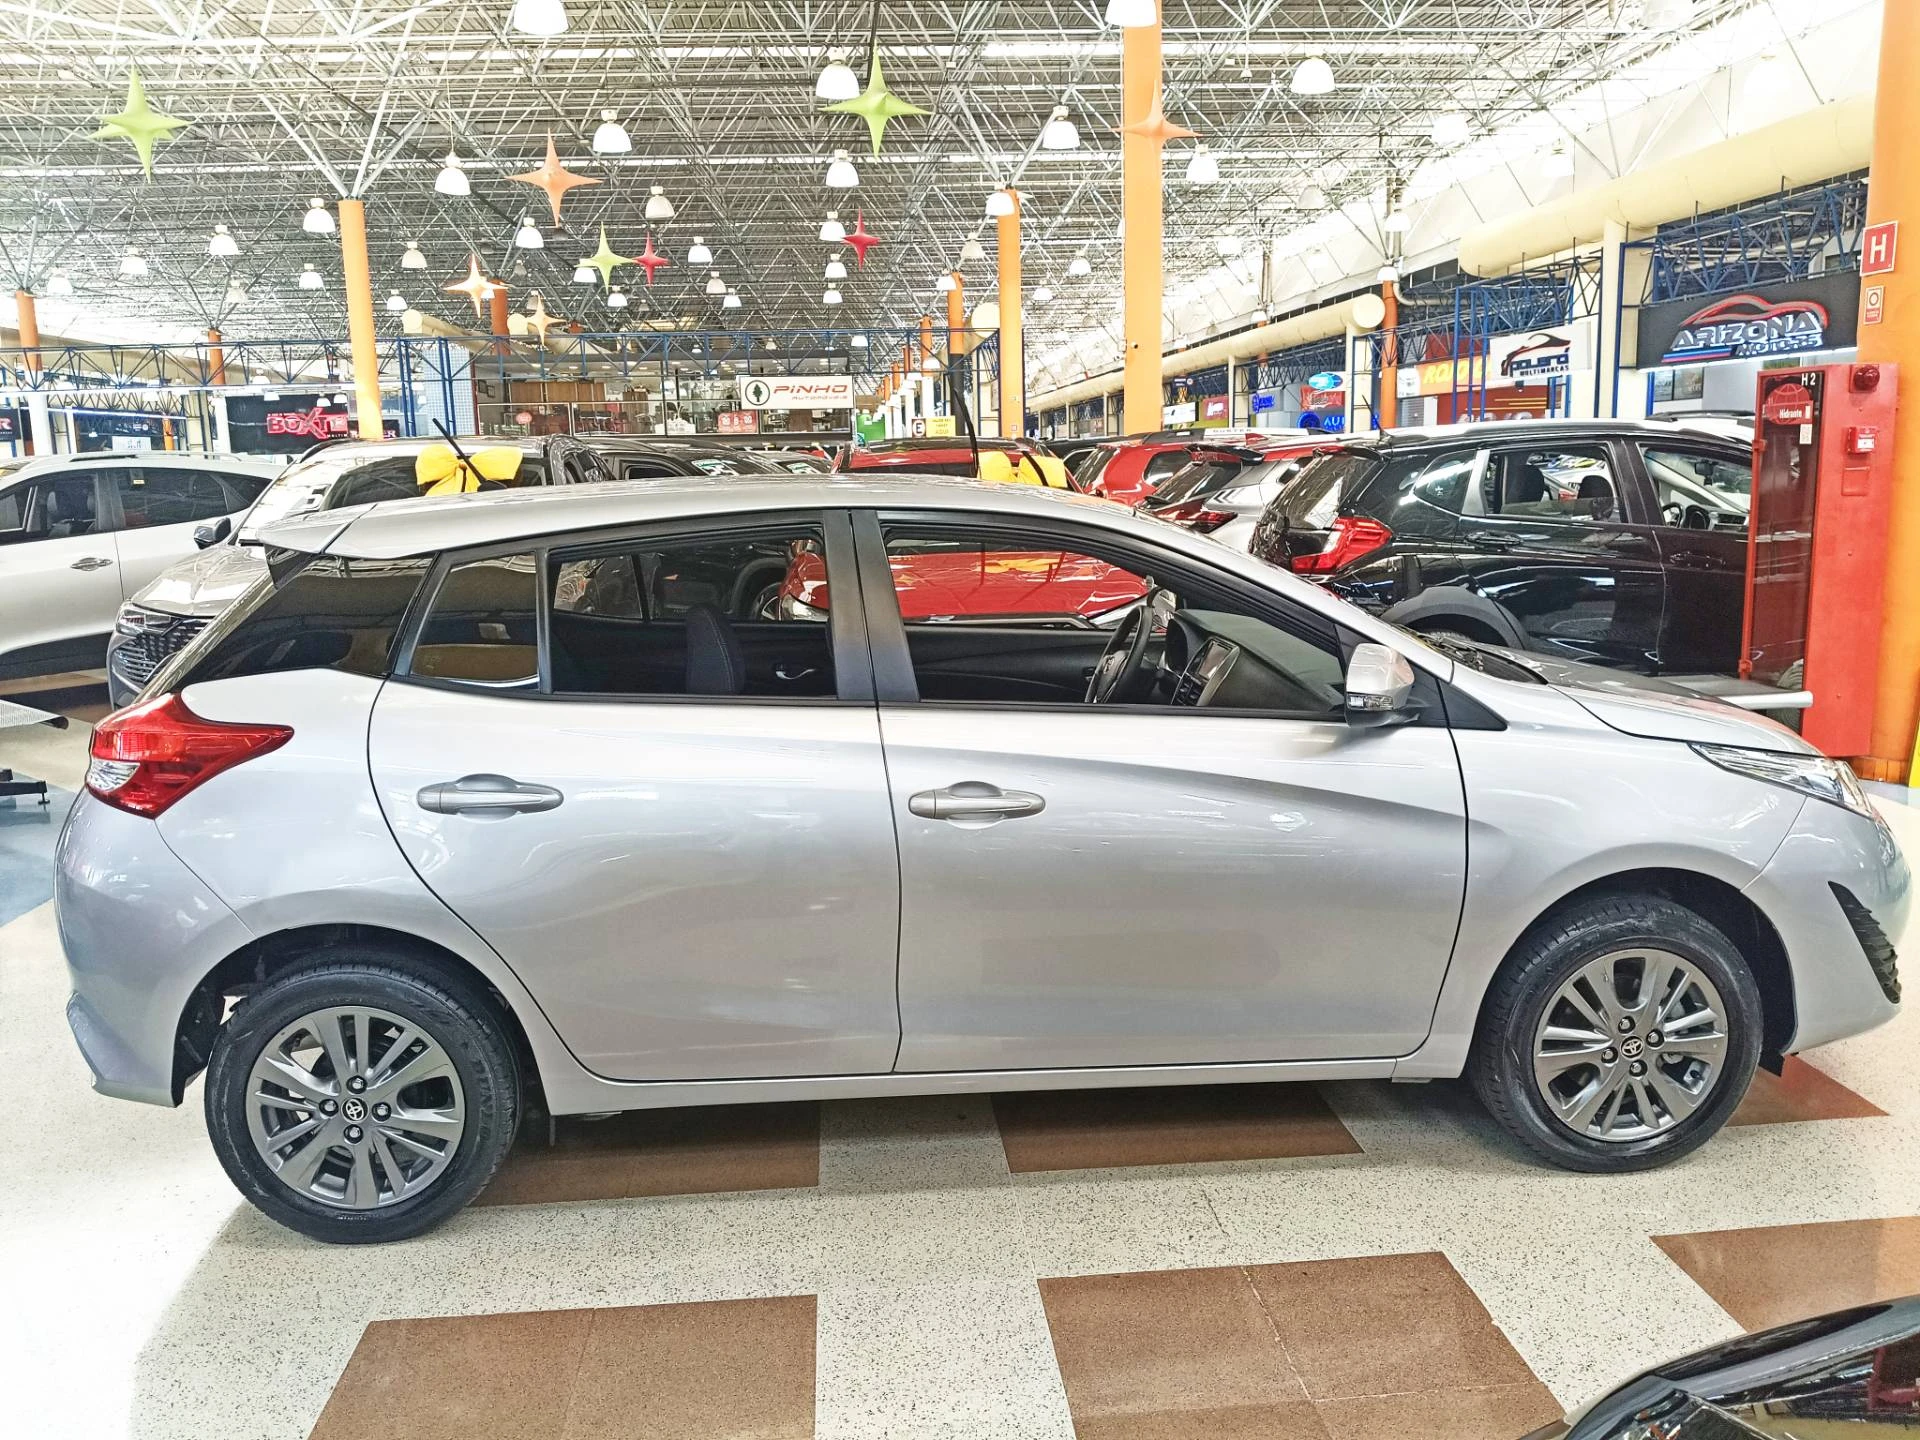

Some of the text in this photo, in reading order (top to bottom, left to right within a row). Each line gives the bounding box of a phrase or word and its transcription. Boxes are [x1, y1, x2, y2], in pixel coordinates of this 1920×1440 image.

[1869, 233, 1887, 265] H
[1671, 311, 1823, 350] ARIZONA
[915, 422, 923, 434] E
